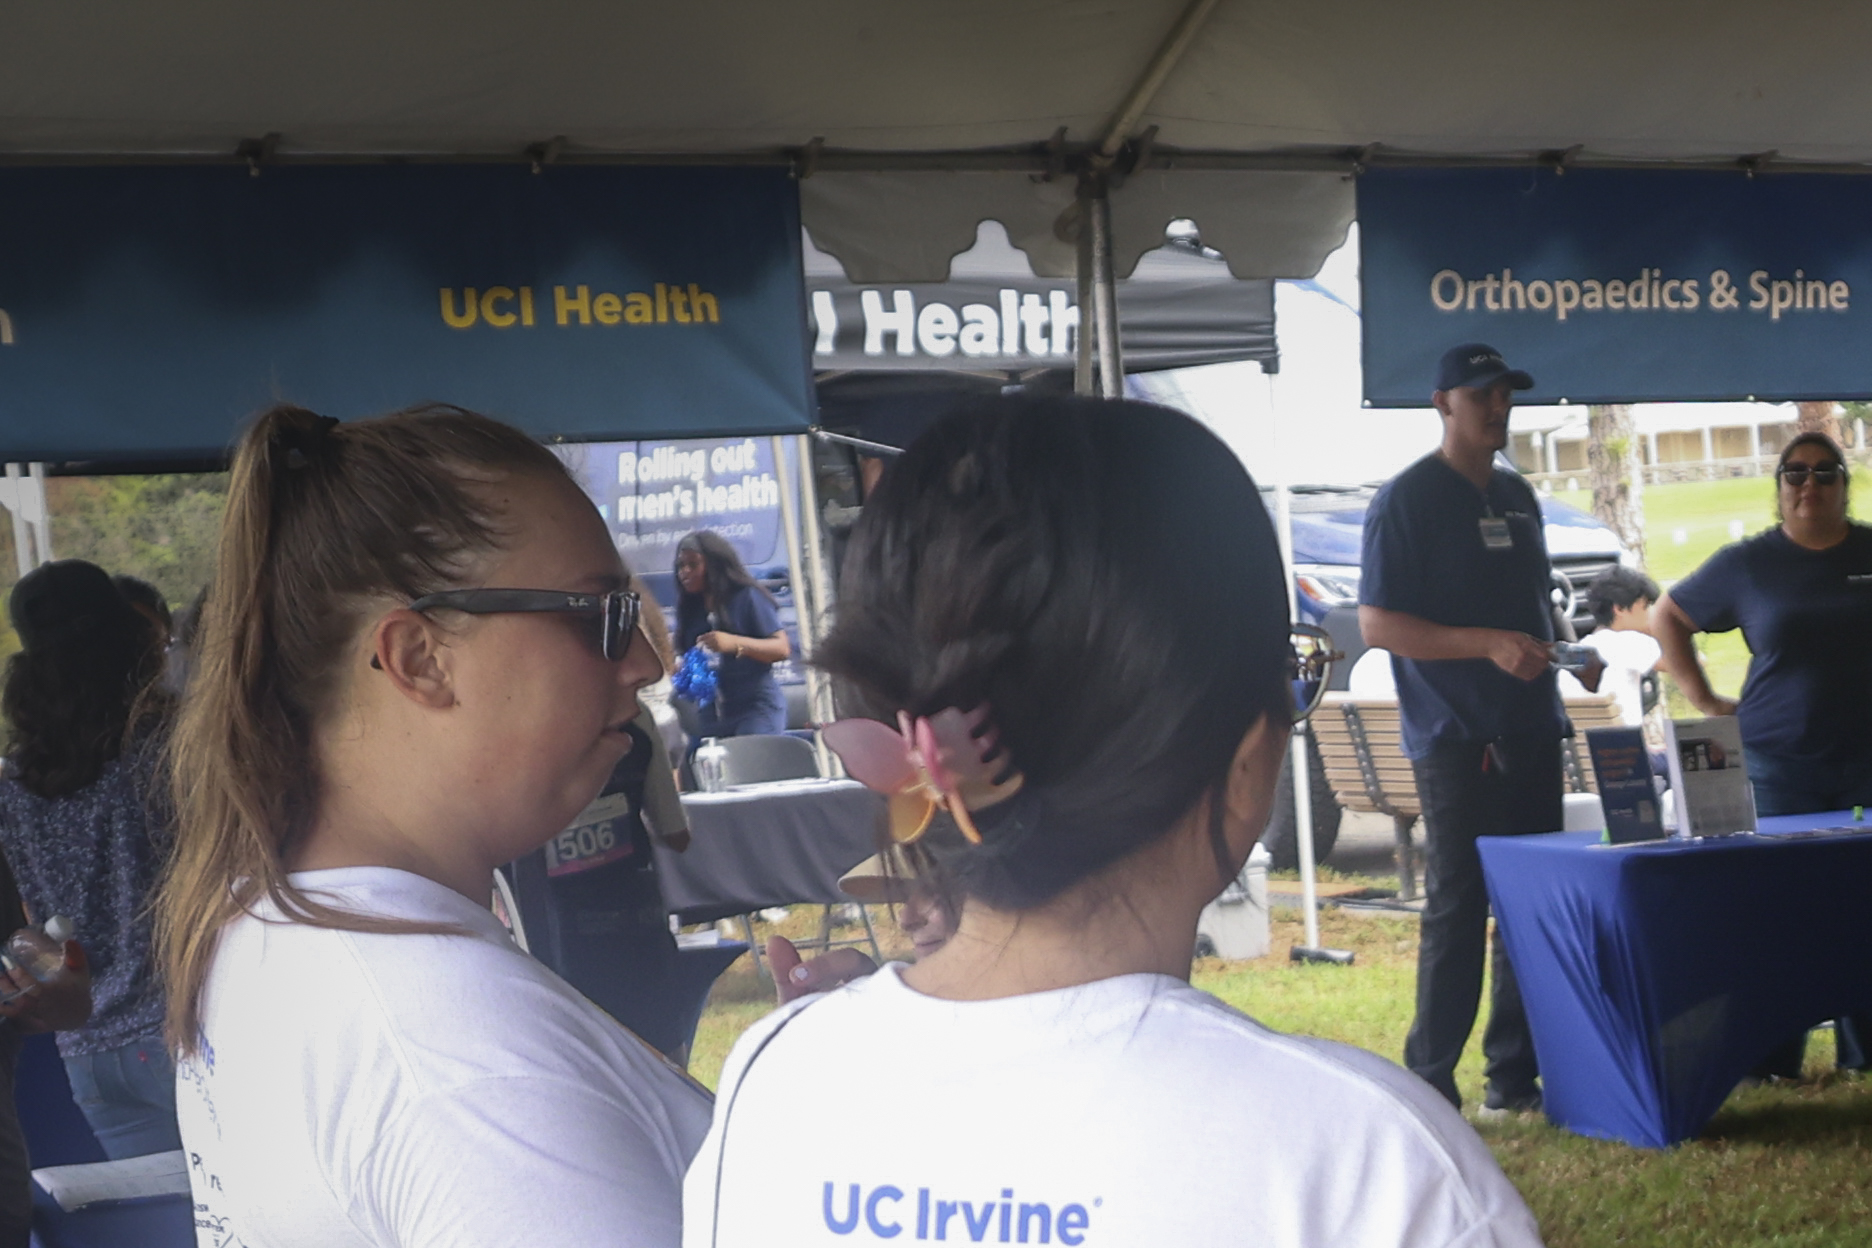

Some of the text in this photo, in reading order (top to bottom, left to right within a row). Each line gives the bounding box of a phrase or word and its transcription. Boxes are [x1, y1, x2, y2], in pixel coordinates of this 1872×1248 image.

[439, 283, 721, 328] UCI Health
[1430, 268, 1850, 320] Orthopaedics & Spine
[618, 438, 757, 484] Rolling out
[618, 473, 779, 523] men's health
[822, 1180, 904, 1239] UC
